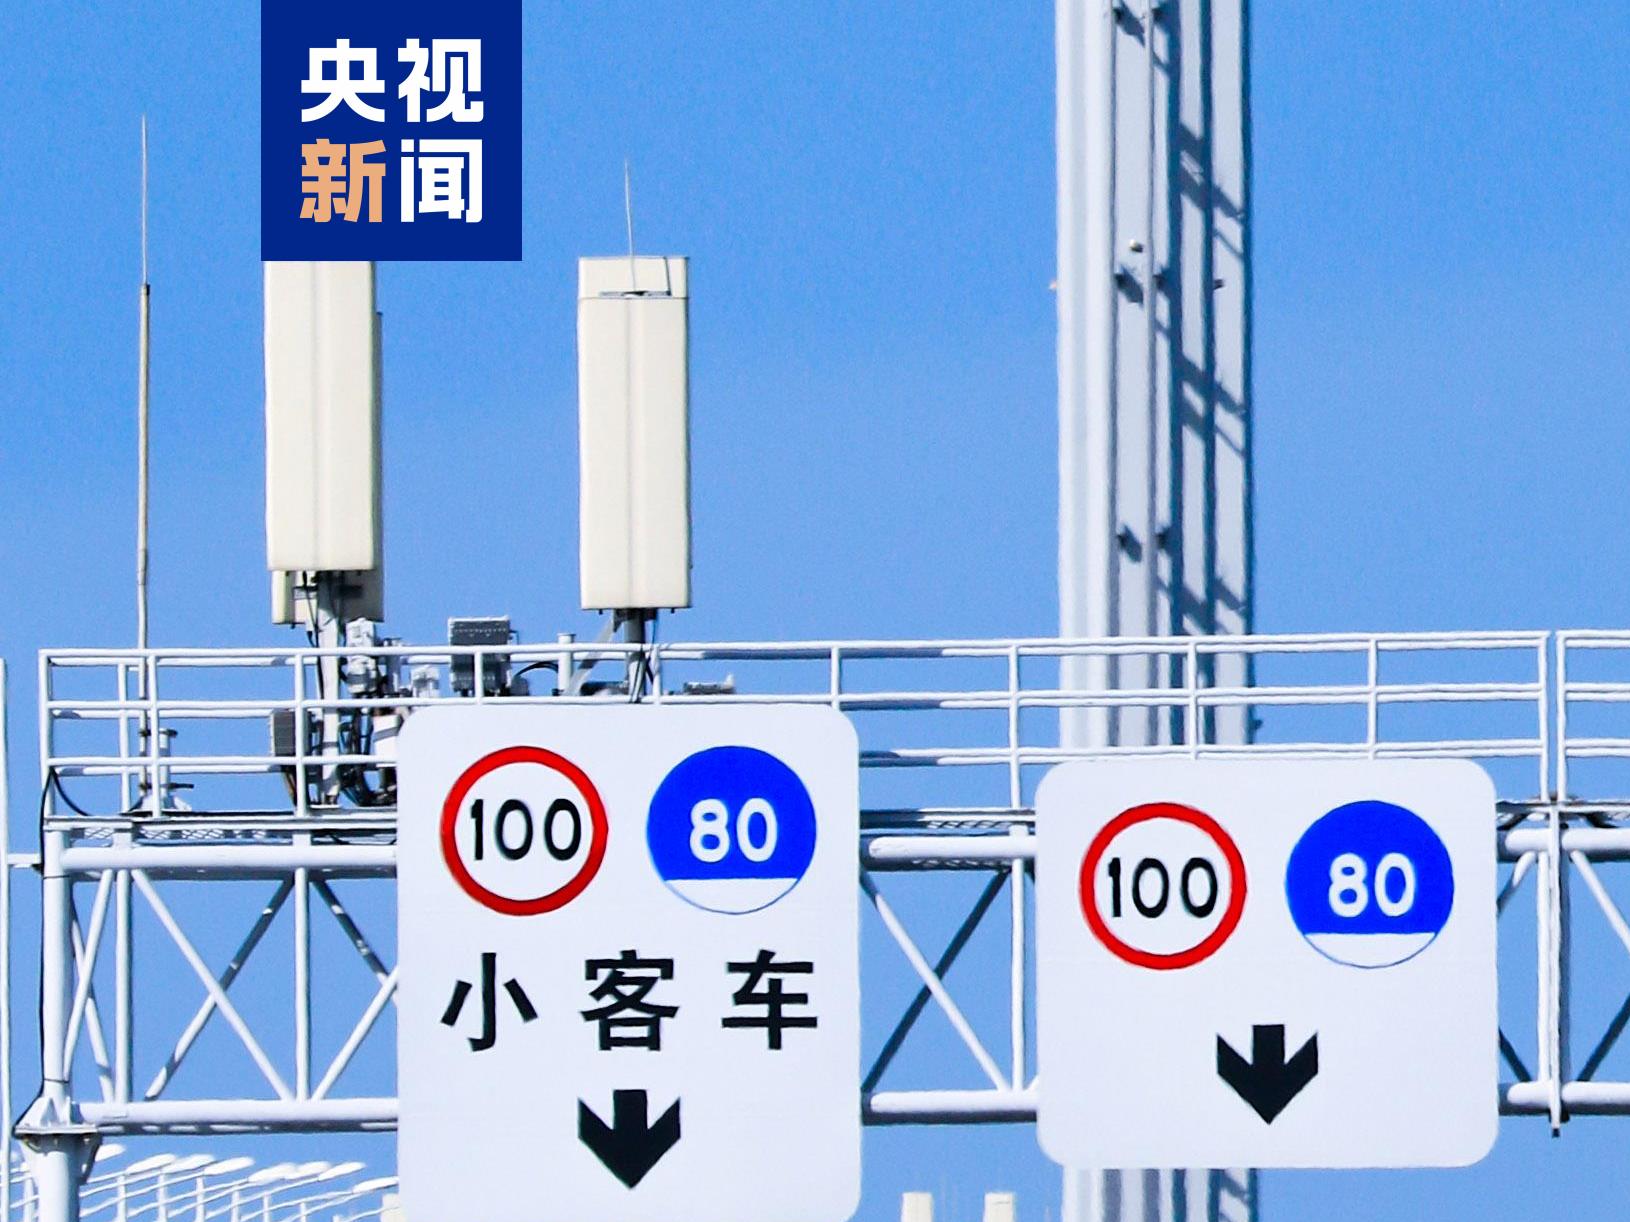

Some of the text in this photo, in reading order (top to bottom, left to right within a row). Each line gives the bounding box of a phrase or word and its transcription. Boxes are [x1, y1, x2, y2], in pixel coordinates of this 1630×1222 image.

[469, 798, 582, 862] 100
[689, 797, 778, 863] 80
[1107, 857, 1218, 919] 100
[1328, 852, 1416, 918] 80
[440, 949, 819, 1052] 小客车
